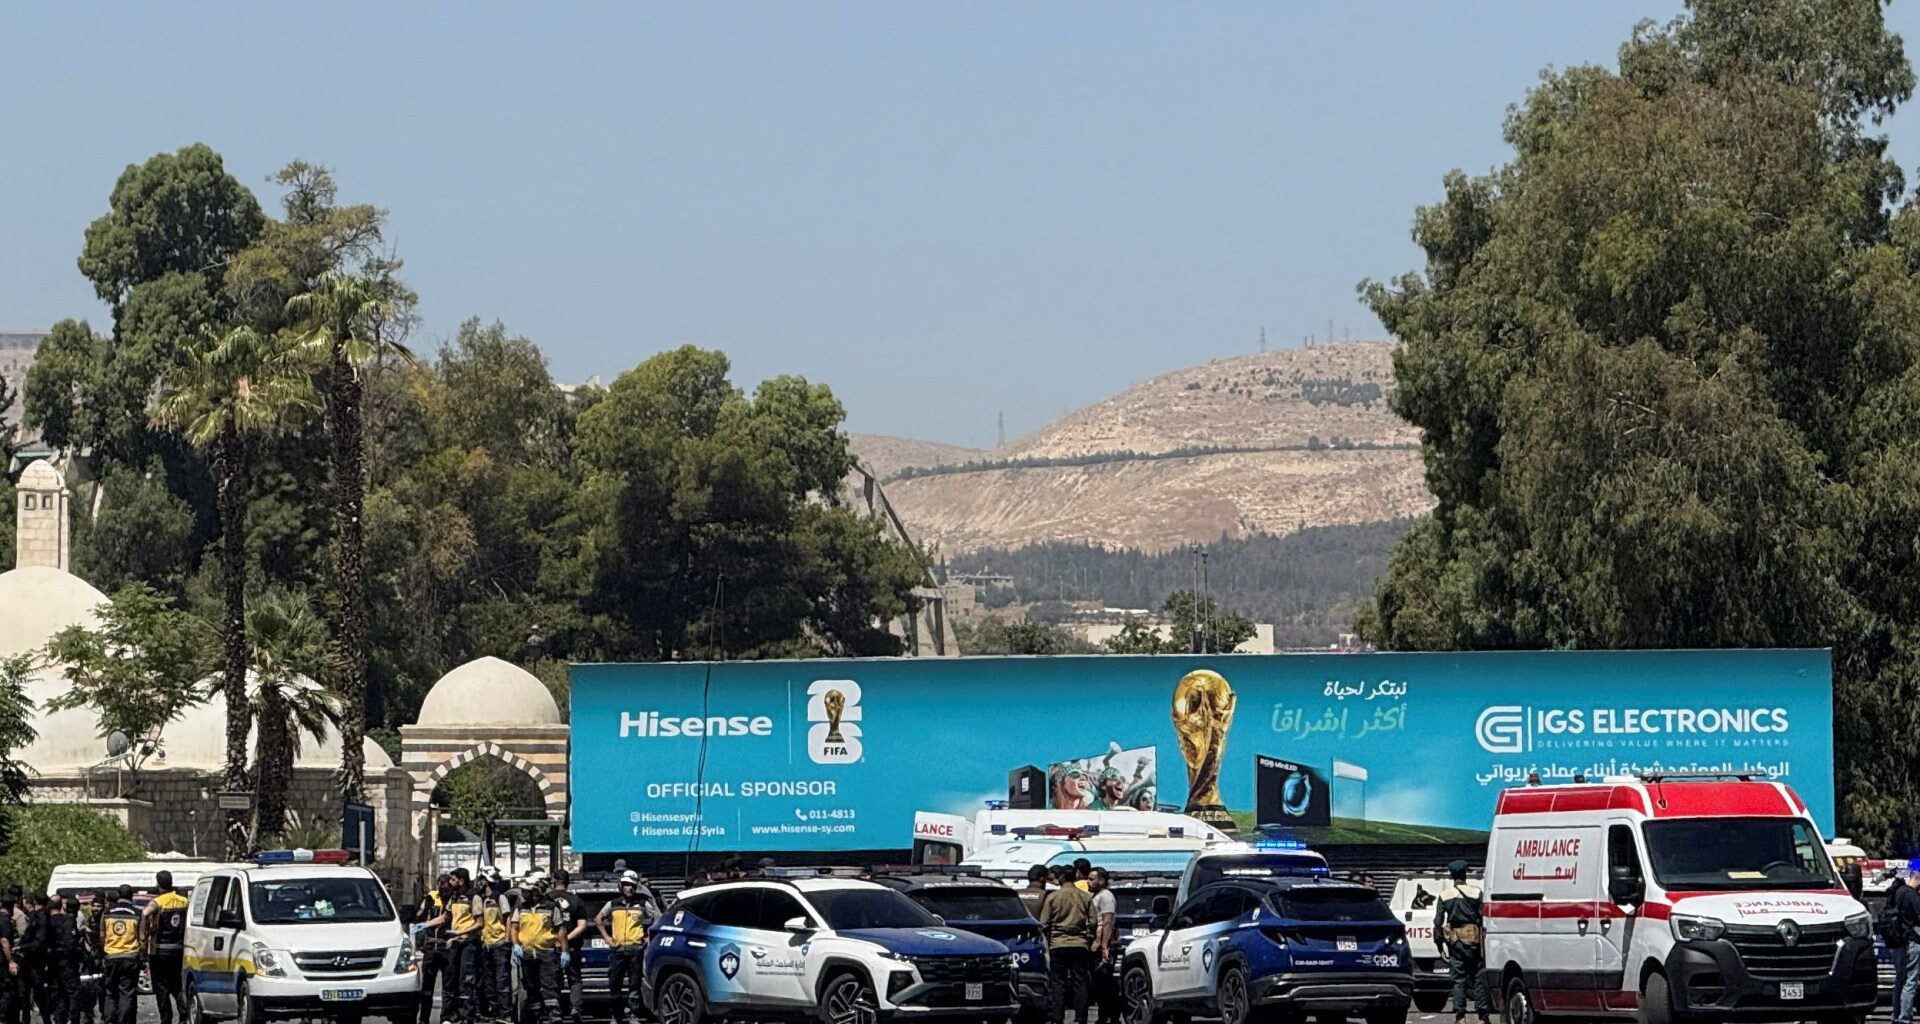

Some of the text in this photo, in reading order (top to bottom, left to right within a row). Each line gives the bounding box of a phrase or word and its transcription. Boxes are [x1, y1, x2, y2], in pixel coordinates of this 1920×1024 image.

[1323, 680, 1407, 700] نبتكر لحياة
[619, 711, 773, 737] Hisense
[1350, 702, 1408, 739] أكثر
[1537, 708, 1789, 734] IGS ELECTRONICS
[823, 746, 848, 756] FIFA
[1537, 738, 1789, 748] DELIVERING VALUE WHERE IT MATTERS
[646, 781, 836, 798] OFFICIAL SPONSOR
[808, 809, 856, 819] 011-4813
[641, 825, 725, 837] Hisense IGS Syria
[751, 824, 856, 834] www.hisense-sy.com
[1514, 838, 1581, 857] AMBULANCE
[1512, 861, 1578, 885] إسعاف
[1404, 927, 1433, 939] MITS
